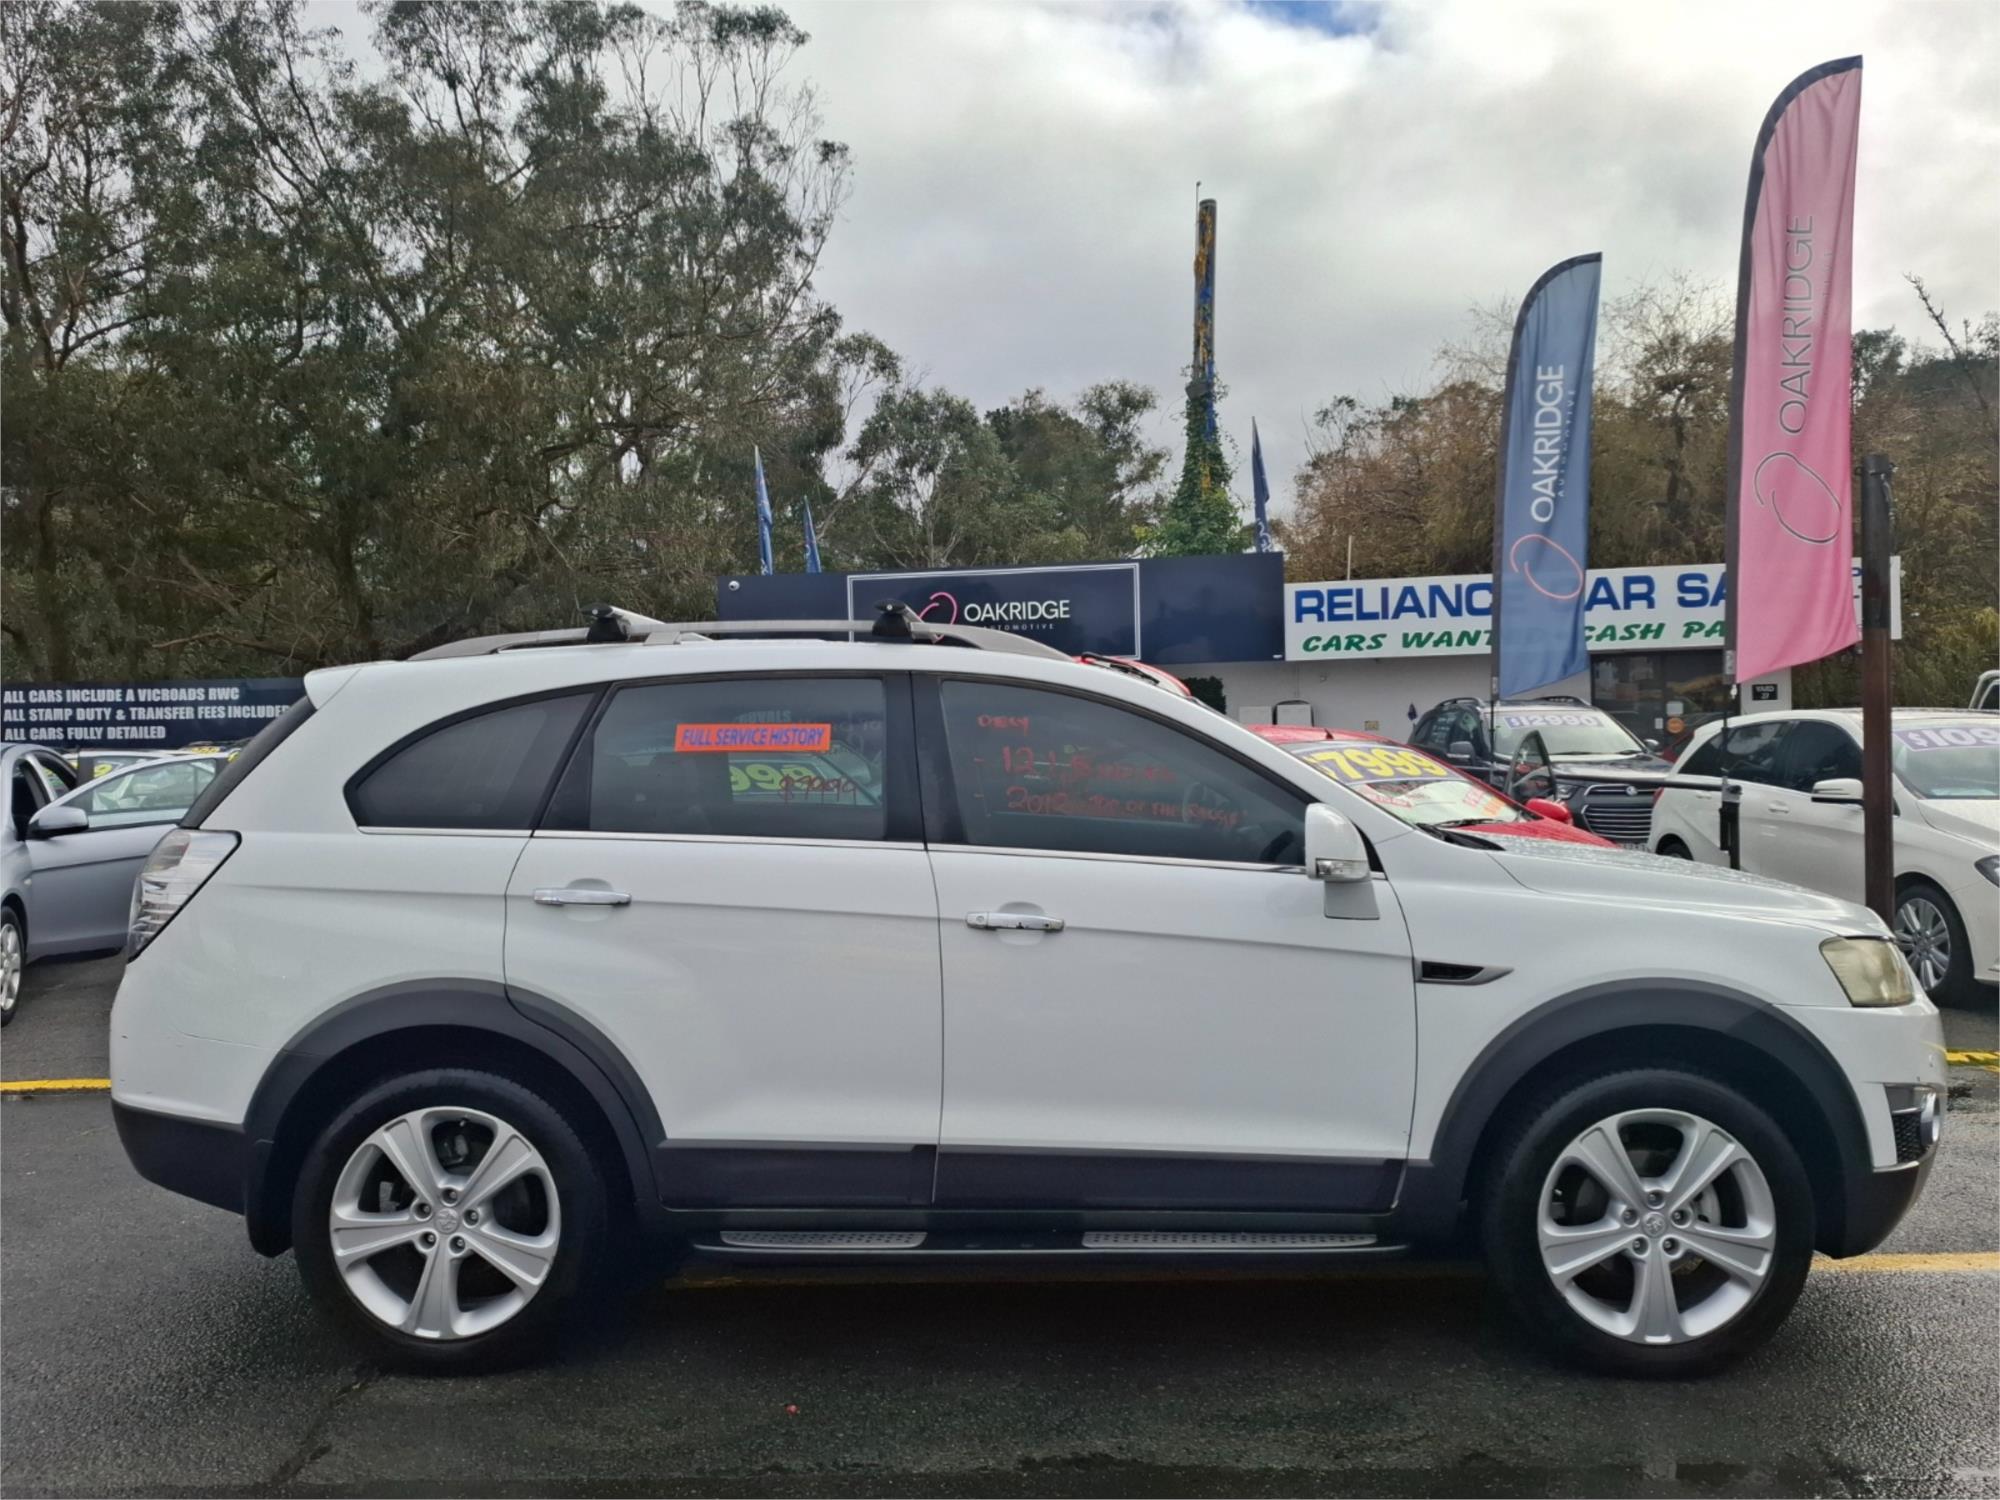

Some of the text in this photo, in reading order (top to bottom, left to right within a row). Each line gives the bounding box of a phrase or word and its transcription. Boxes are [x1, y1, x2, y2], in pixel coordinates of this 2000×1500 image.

[1779, 215, 1814, 434] OAKRIDGE
[1531, 365, 1565, 522] OAKRIDGE
[1294, 582, 1493, 623] RELIANC
[1583, 575, 1656, 611] AR
[963, 600, 1072, 622] OAKRIDGE
[1302, 620, 1727, 652] CARS WANT CASH PA
[3, 687, 240, 704] ALL CARS INCLUDE A VICROADS RWC
[3, 708, 26, 722] ALL
[28, 708, 73, 721] STAMP
[76, 707, 111, 721] DUTY
[115, 708, 126, 721] &
[129, 706, 194, 721] TRANSFER
[197, 705, 226, 719] FEES
[4, 726, 166, 741] ALL CARS FULLY DETAILED
[681, 728, 824, 746] FULL SERVICE HISTORY
